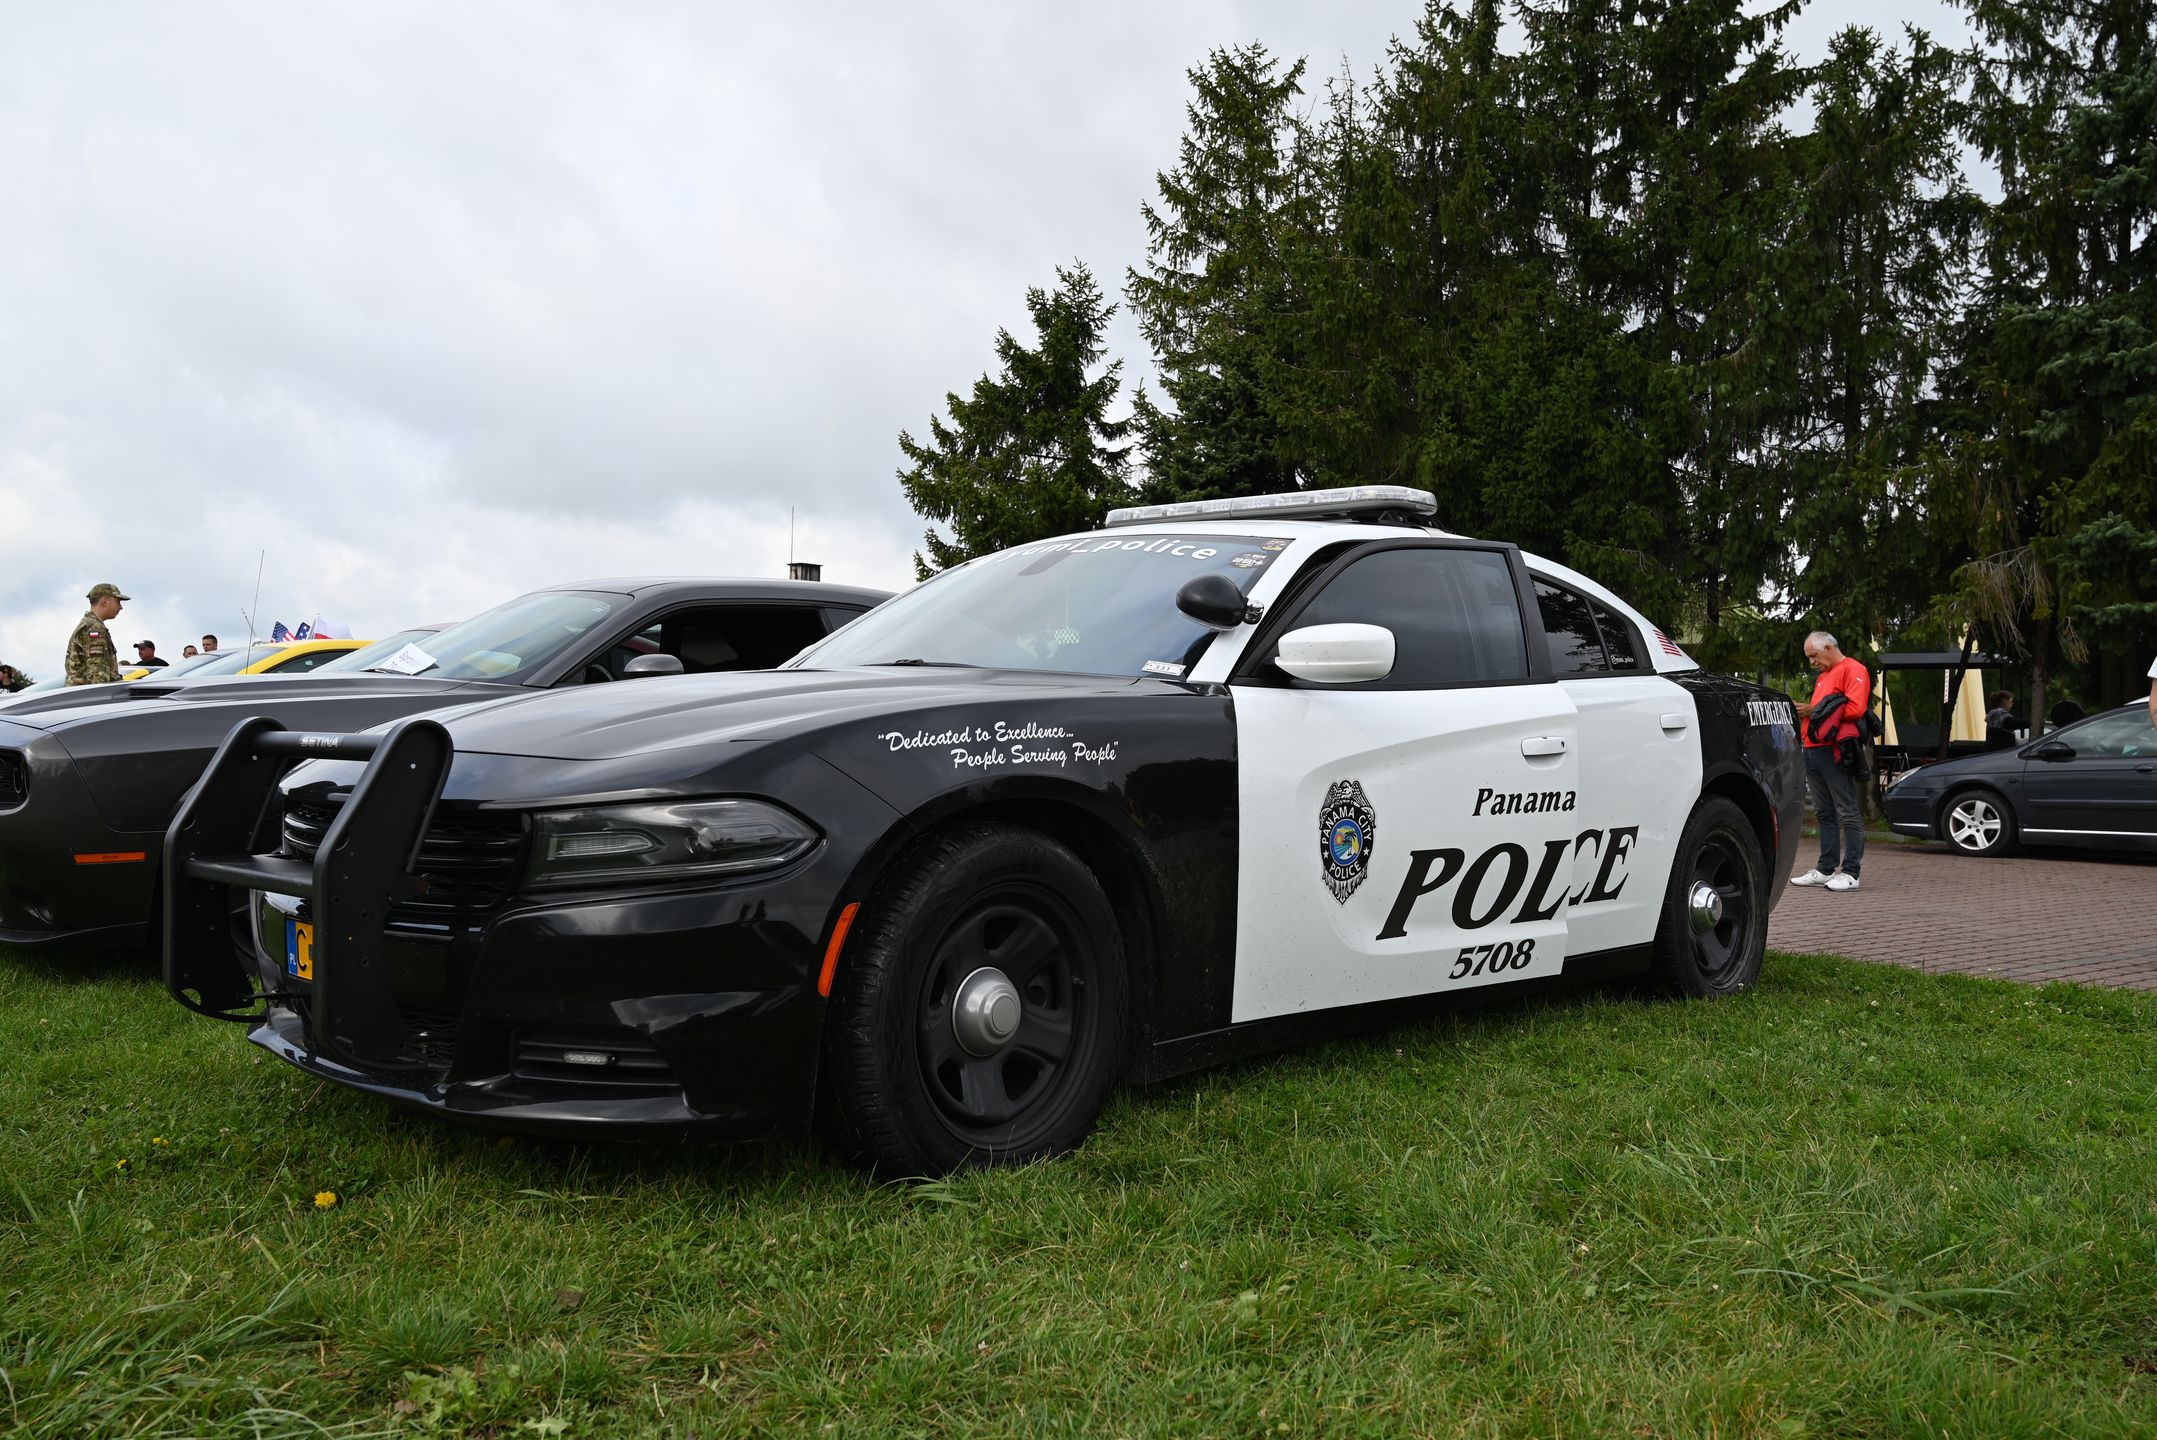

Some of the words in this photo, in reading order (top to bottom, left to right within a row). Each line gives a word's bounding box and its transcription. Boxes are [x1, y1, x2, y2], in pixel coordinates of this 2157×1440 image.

[1746, 701, 1793, 726] EMERGENCY
[300, 736, 338, 748] SETINA
[975, 727, 991, 742] to
[994, 721, 1074, 742] Excellence...
[950, 748, 1006, 770] People
[1010, 744, 1067, 768] Serving
[1472, 787, 1577, 816] Panama
[1321, 806, 1355, 845] PANAMA
[1358, 814, 1372, 841] CITY
[1329, 860, 1361, 880] POLICE
[1375, 824, 1640, 941] POLCE
[1447, 938, 1536, 980] 5708
